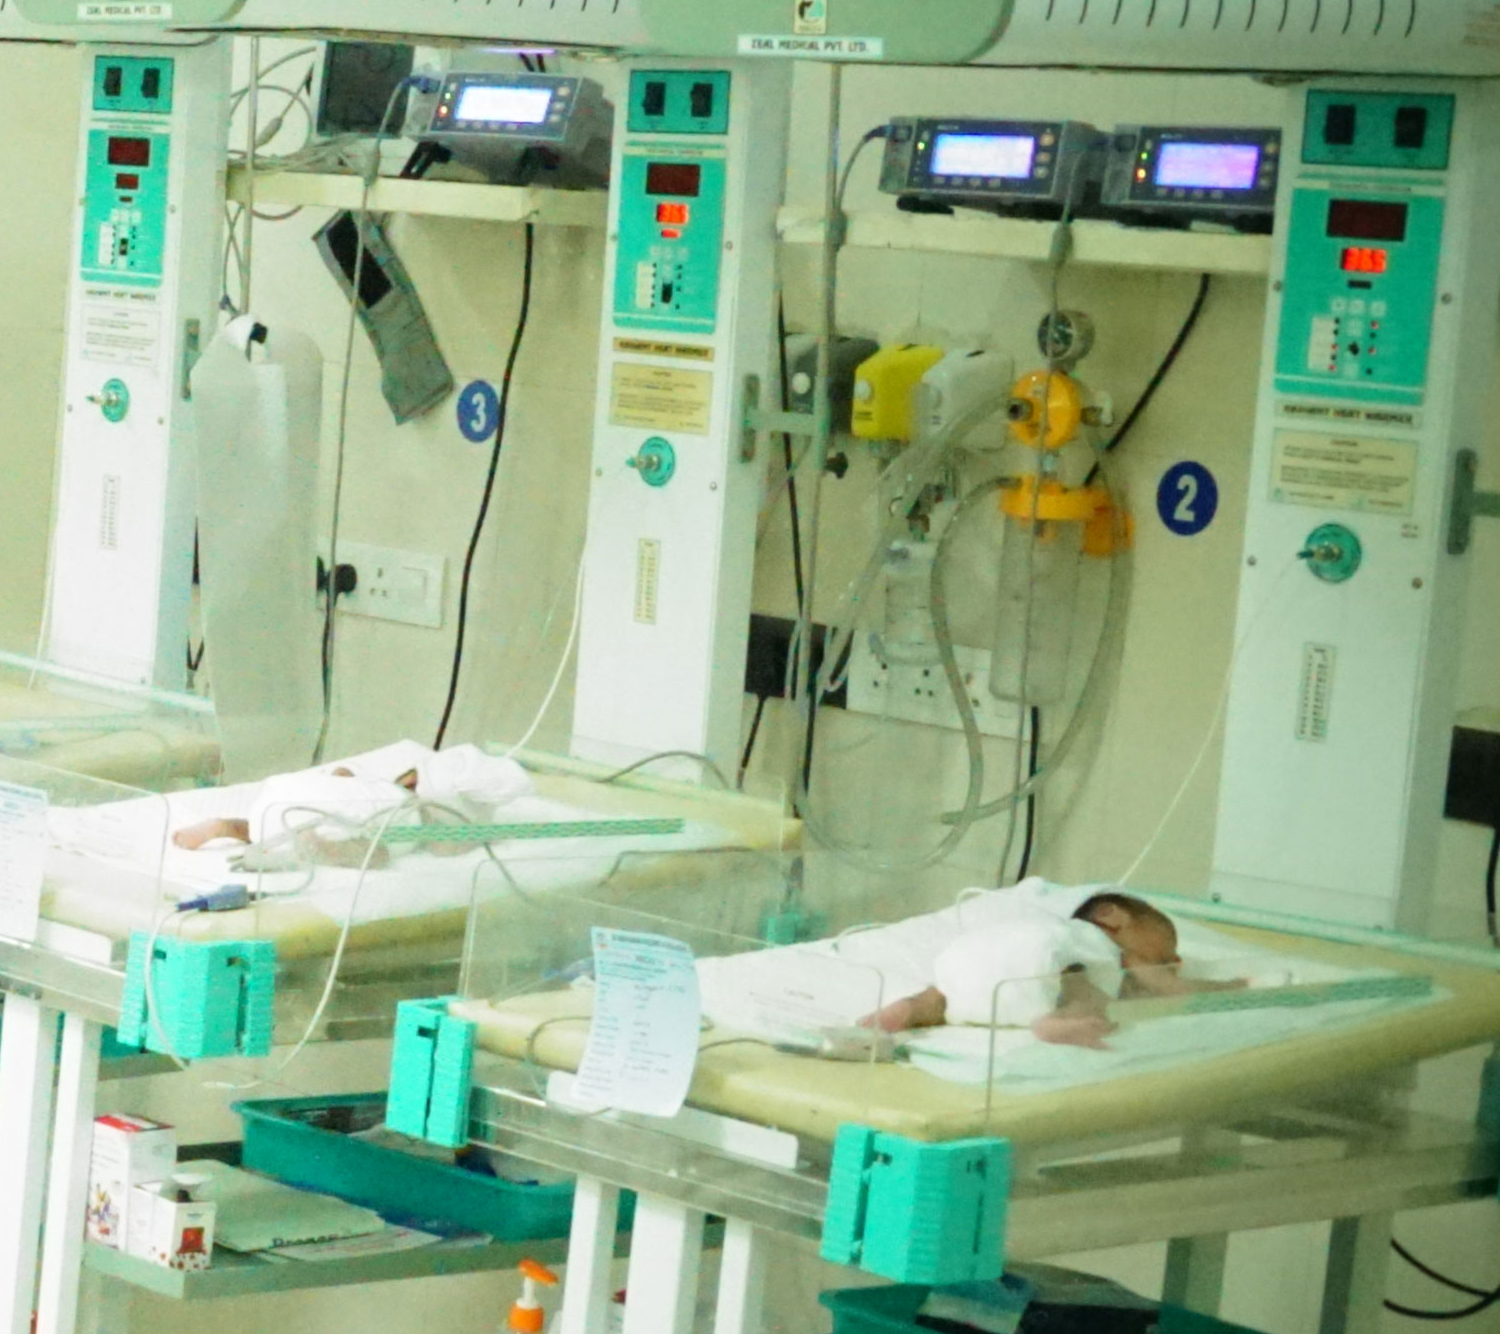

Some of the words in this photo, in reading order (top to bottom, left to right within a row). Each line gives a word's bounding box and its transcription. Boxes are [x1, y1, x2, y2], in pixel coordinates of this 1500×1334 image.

[778, 39, 820, 51] MEDICAL
[470, 392, 487, 433] 3
[1173, 473, 1199, 523] 2
